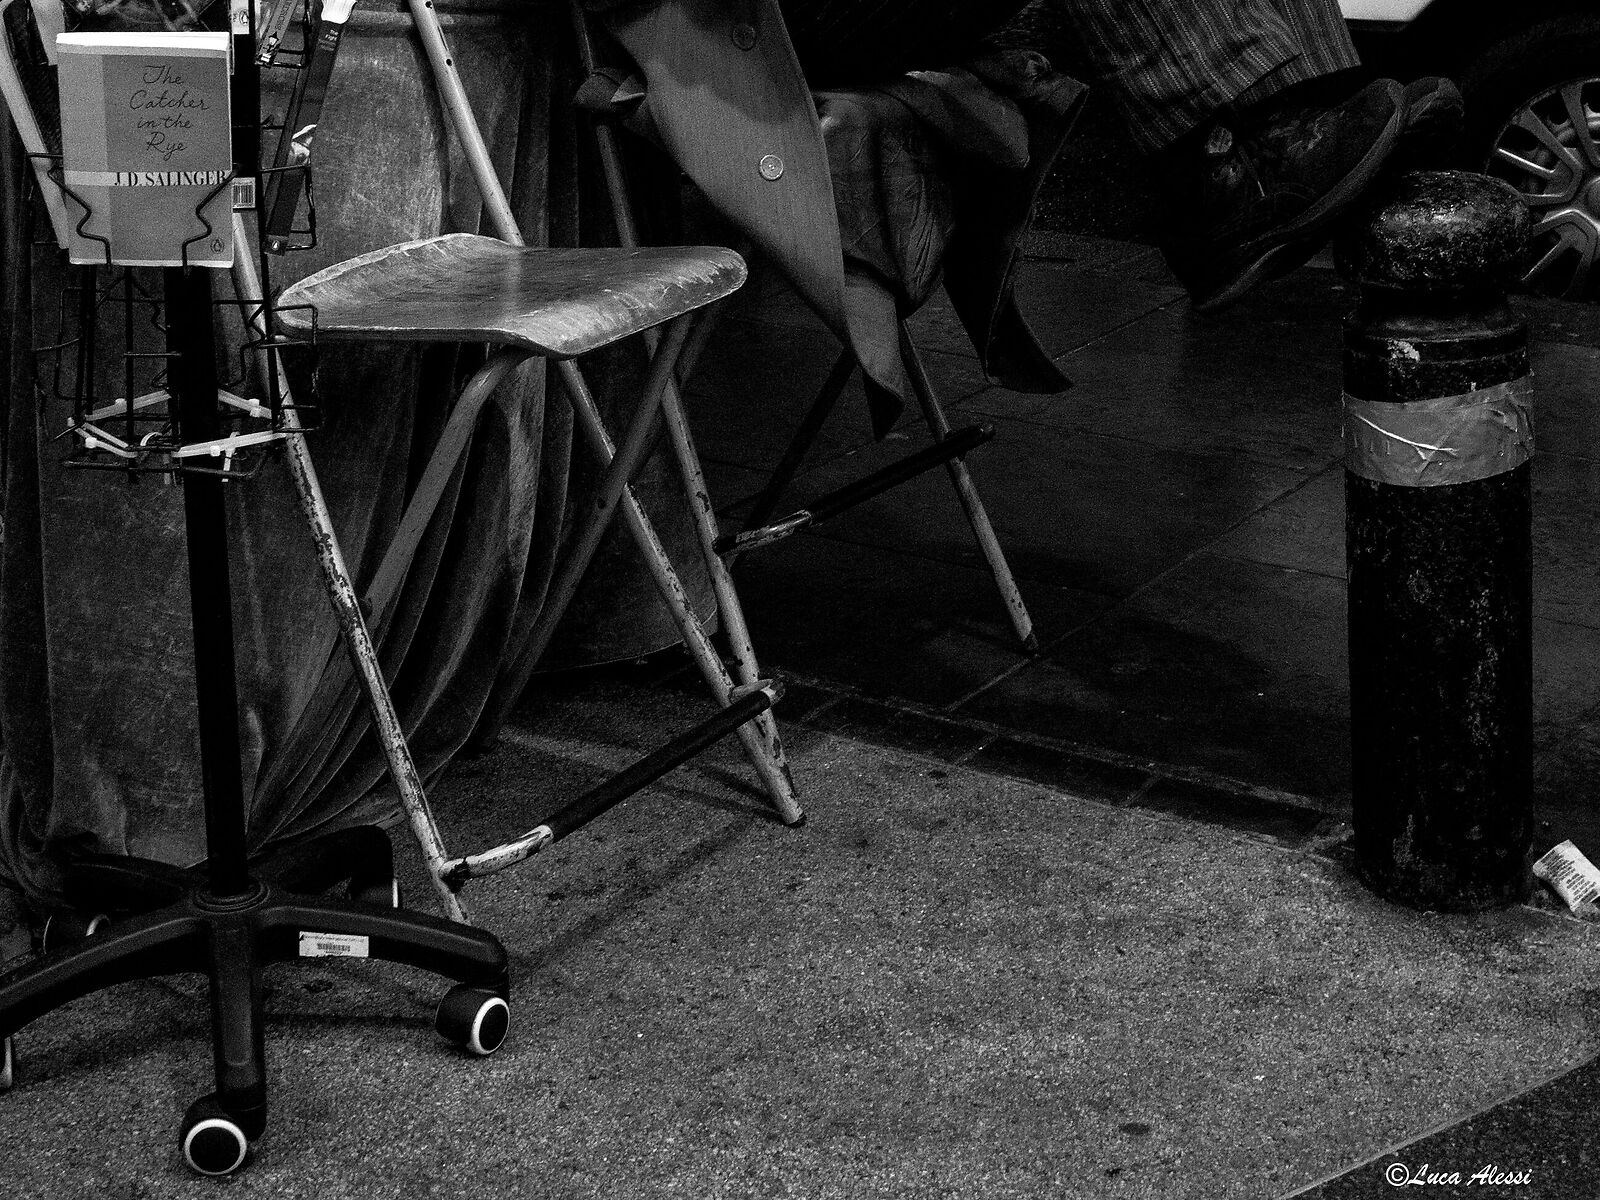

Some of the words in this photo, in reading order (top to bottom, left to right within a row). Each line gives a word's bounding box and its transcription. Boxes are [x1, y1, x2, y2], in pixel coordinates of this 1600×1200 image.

[142, 65, 185, 85] The
[129, 89, 210, 111] Catcher
[137, 116, 160, 129] in
[160, 113, 193, 129] the
[146, 131, 188, 162] Rye
[145, 171, 226, 187] SALINGER
